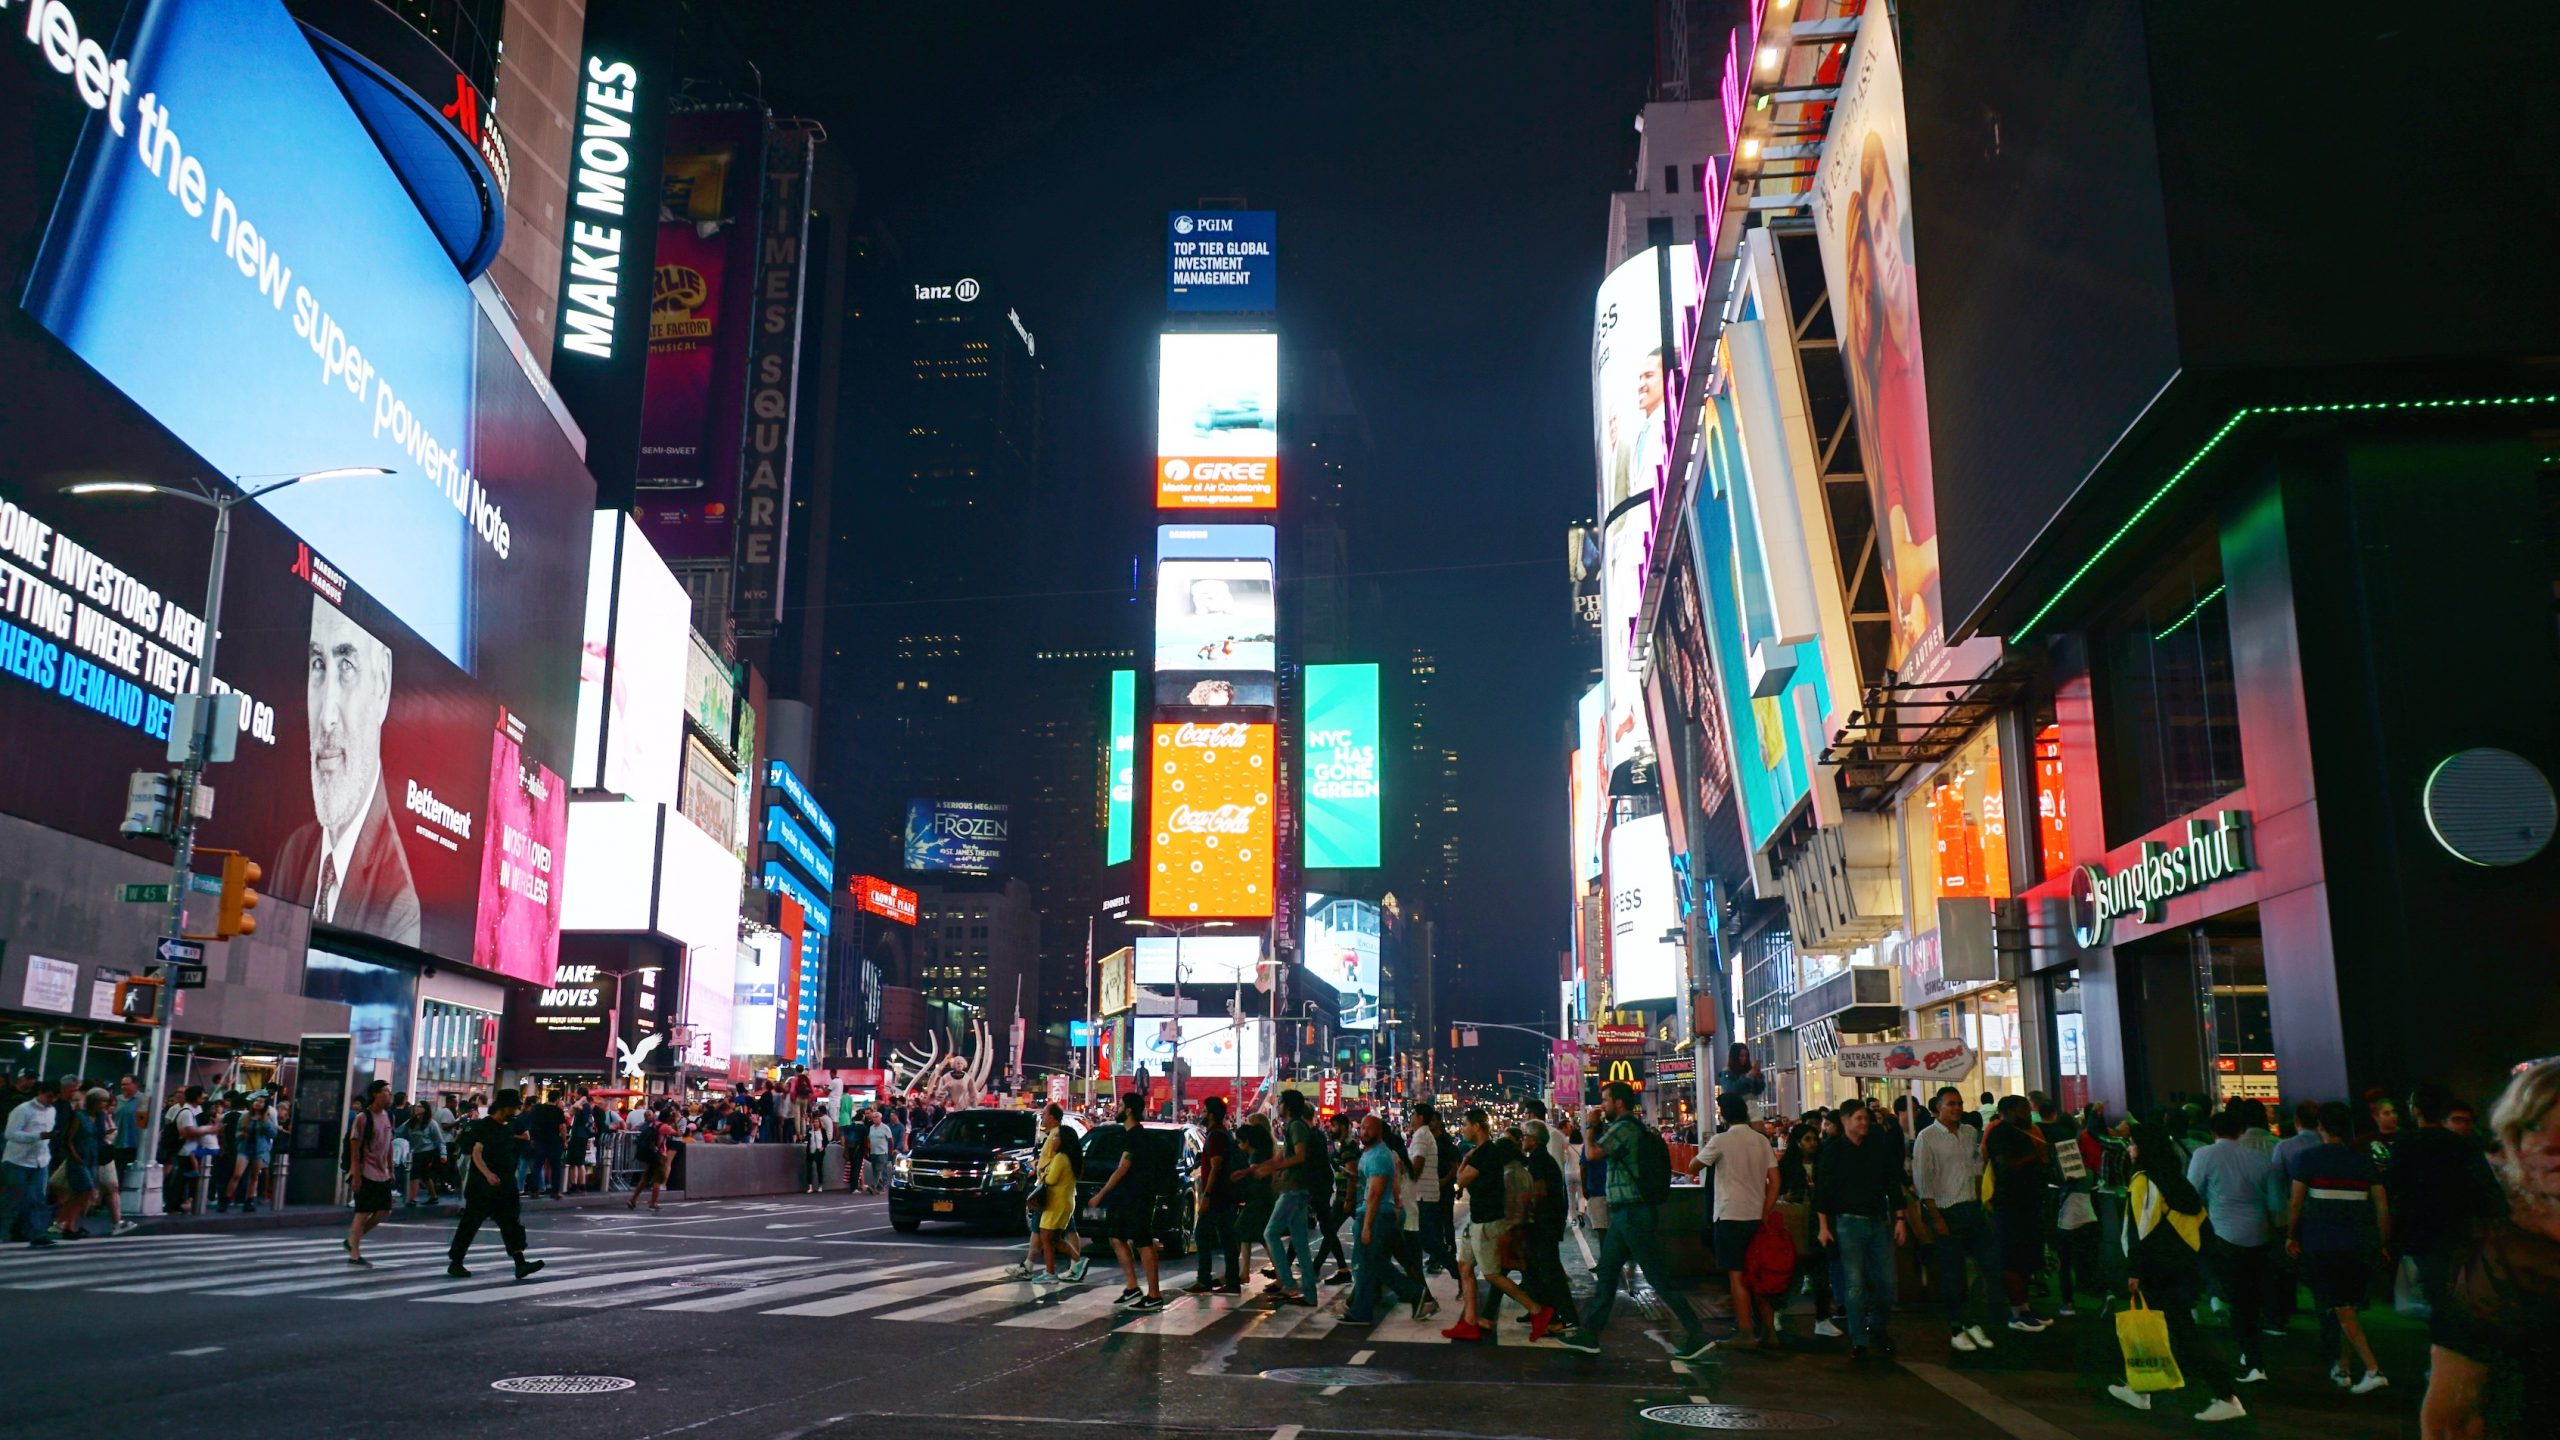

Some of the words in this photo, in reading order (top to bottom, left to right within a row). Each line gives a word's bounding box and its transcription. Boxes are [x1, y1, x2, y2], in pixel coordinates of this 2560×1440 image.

[576, 56, 638, 216] MOVES
[1197, 219, 1233, 232] PGIM
[764, 173, 799, 333] TIMES
[1174, 242, 1196, 255] TOP
[1199, 242, 1224, 255] TIER
[1227, 242, 1270, 255] GLOBAL
[1174, 257, 1243, 270] INVESTMENT
[1174, 272, 1250, 285] MANAGEMENT
[562, 220, 622, 358] MAKE
[138, 93, 208, 218] the
[210, 186, 292, 311] new
[292, 285, 375, 403] super
[372, 377, 471, 518] powerful
[469, 478, 511, 560] Note
[667, 321, 708, 336] FACTORY
[641, 447, 697, 455] SEMI-SWEET
[746, 355, 786, 564] SQUARE
[1192, 462, 1268, 481] GREE
[1162, 483, 1192, 493] Master
[1193, 482, 1203, 493] of
[1204, 482, 1217, 493] Air
[1217, 483, 1272, 495] Conditioning
[0, 501, 52, 570] OME
[51, 532, 162, 633] INVESTORS
[313, 556, 348, 591] MARRIOTT
[311, 571, 342, 603] MARQUIS
[743, 590, 768, 600] NYC
[74, 602, 144, 676] WHERE
[143, 640, 192, 695] THEY
[252, 700, 276, 745] GO.
[59, 651, 144, 728] DEMAND
[1174, 722, 1250, 748] Coca-Cola
[1309, 730, 1352, 748] NYC
[1334, 746, 1375, 764] HAS
[1314, 763, 1373, 781] GONE
[1312, 780, 1380, 799] GREEN
[405, 778, 472, 840] Betterment
[943, 802, 973, 810] SERIOUS
[934, 813, 1008, 840] FROZEN
[1168, 803, 1257, 833] Coca-Cola
[503, 824, 528, 858] MOST
[528, 837, 552, 873] LOVED
[955, 848, 973, 856] JAMES
[975, 849, 999, 857] THEATRE
[2098, 842, 2187, 925] sunglass
[2187, 809, 2234, 885] hut
[500, 859, 511, 889] IN
[511, 866, 549, 906] WIRELESS
[540, 988, 600, 1006] MOVES
[1597, 1030, 1646, 1039] McDonald's
[1841, 1052, 1881, 1061] ENTRANCE
[1858, 1060, 1878, 1068] 45TH
[1324, 1079, 1338, 1106] tkts
